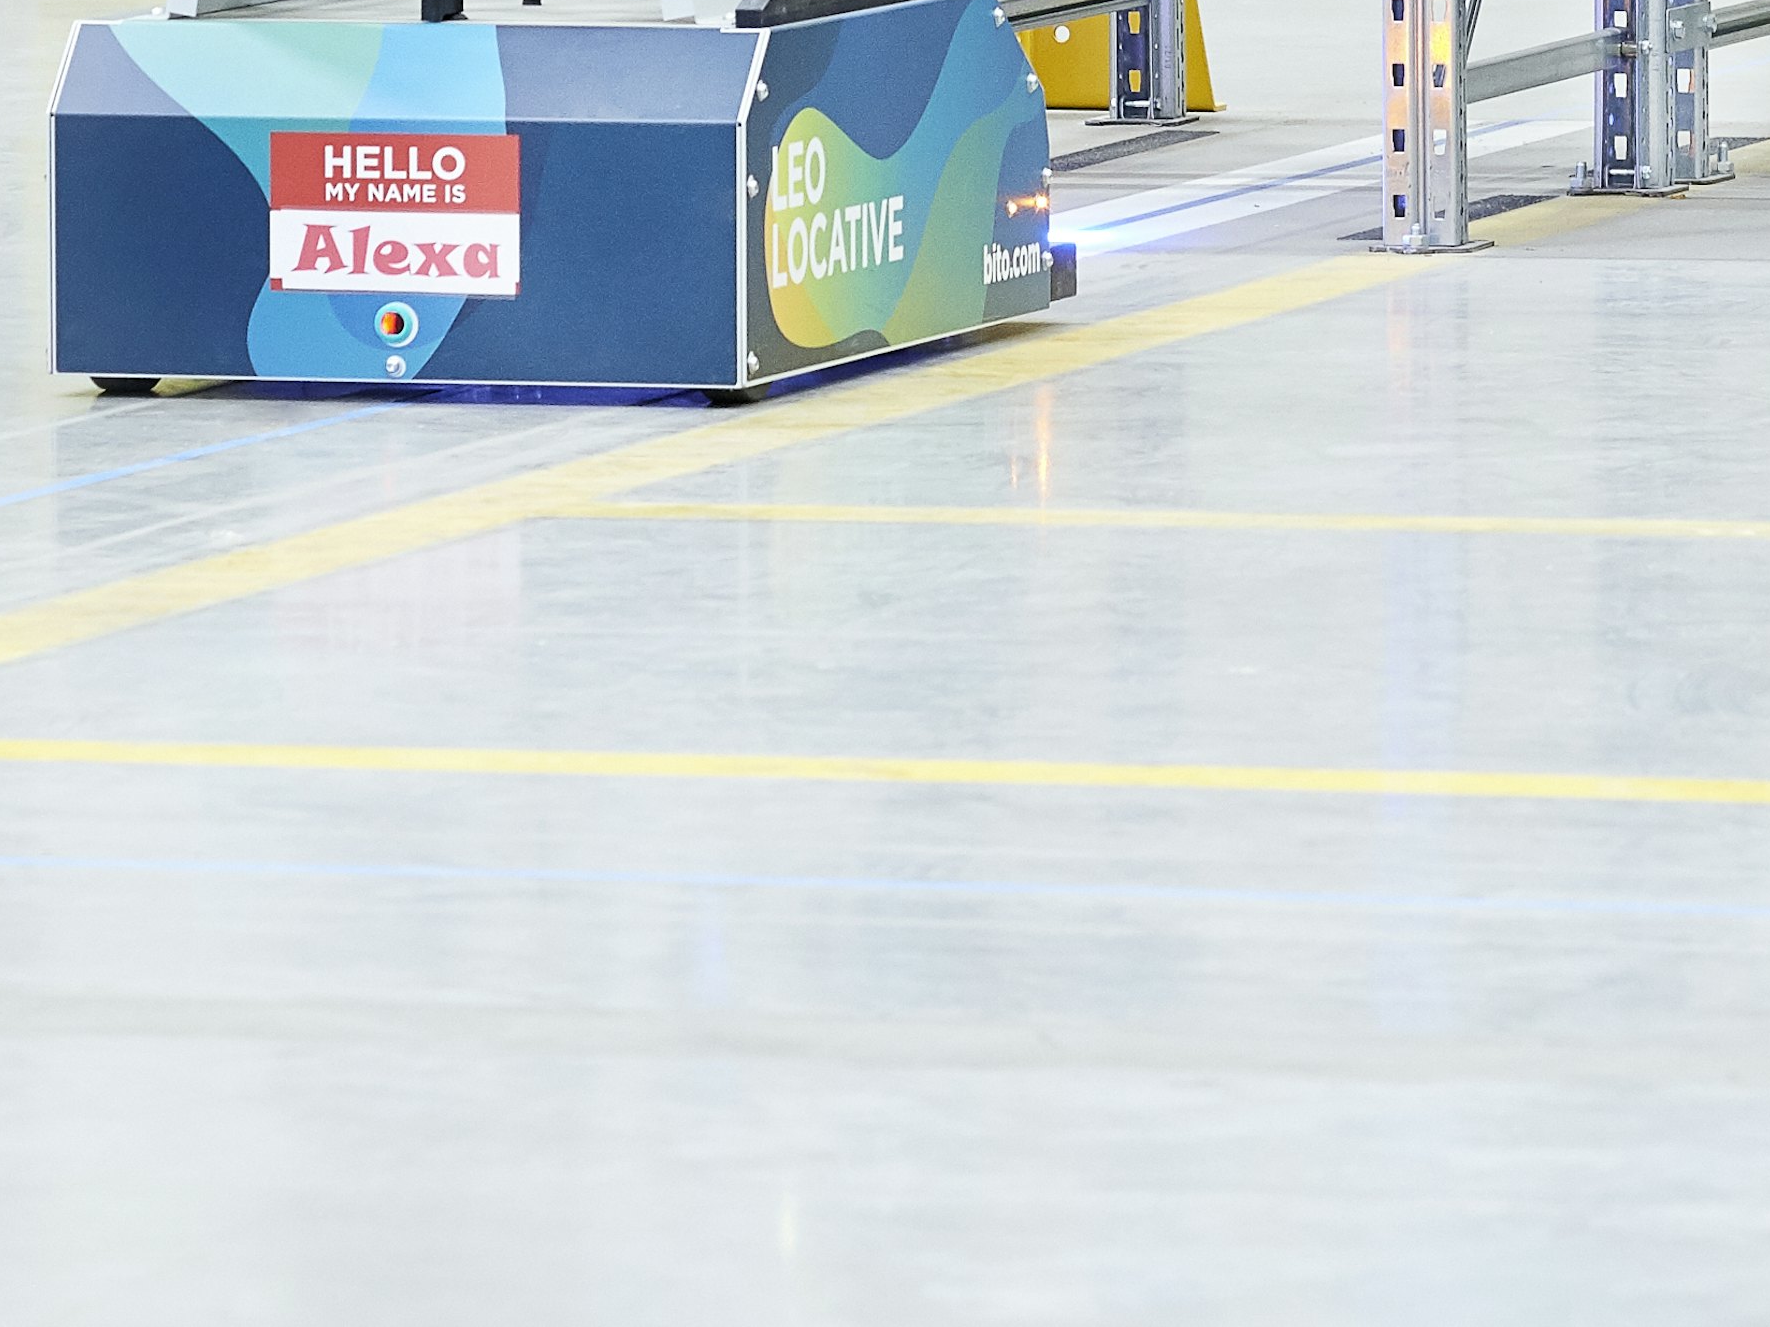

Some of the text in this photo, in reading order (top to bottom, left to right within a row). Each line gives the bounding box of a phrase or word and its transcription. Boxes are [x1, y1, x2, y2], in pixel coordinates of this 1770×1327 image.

[324, 144, 466, 181] HELLO
[772, 136, 826, 212] LEO
[325, 183, 466, 204] MY NAME IS
[291, 223, 500, 279] Alexa
[772, 195, 904, 288] LOCATIVE
[983, 242, 1041, 285] bito.com
